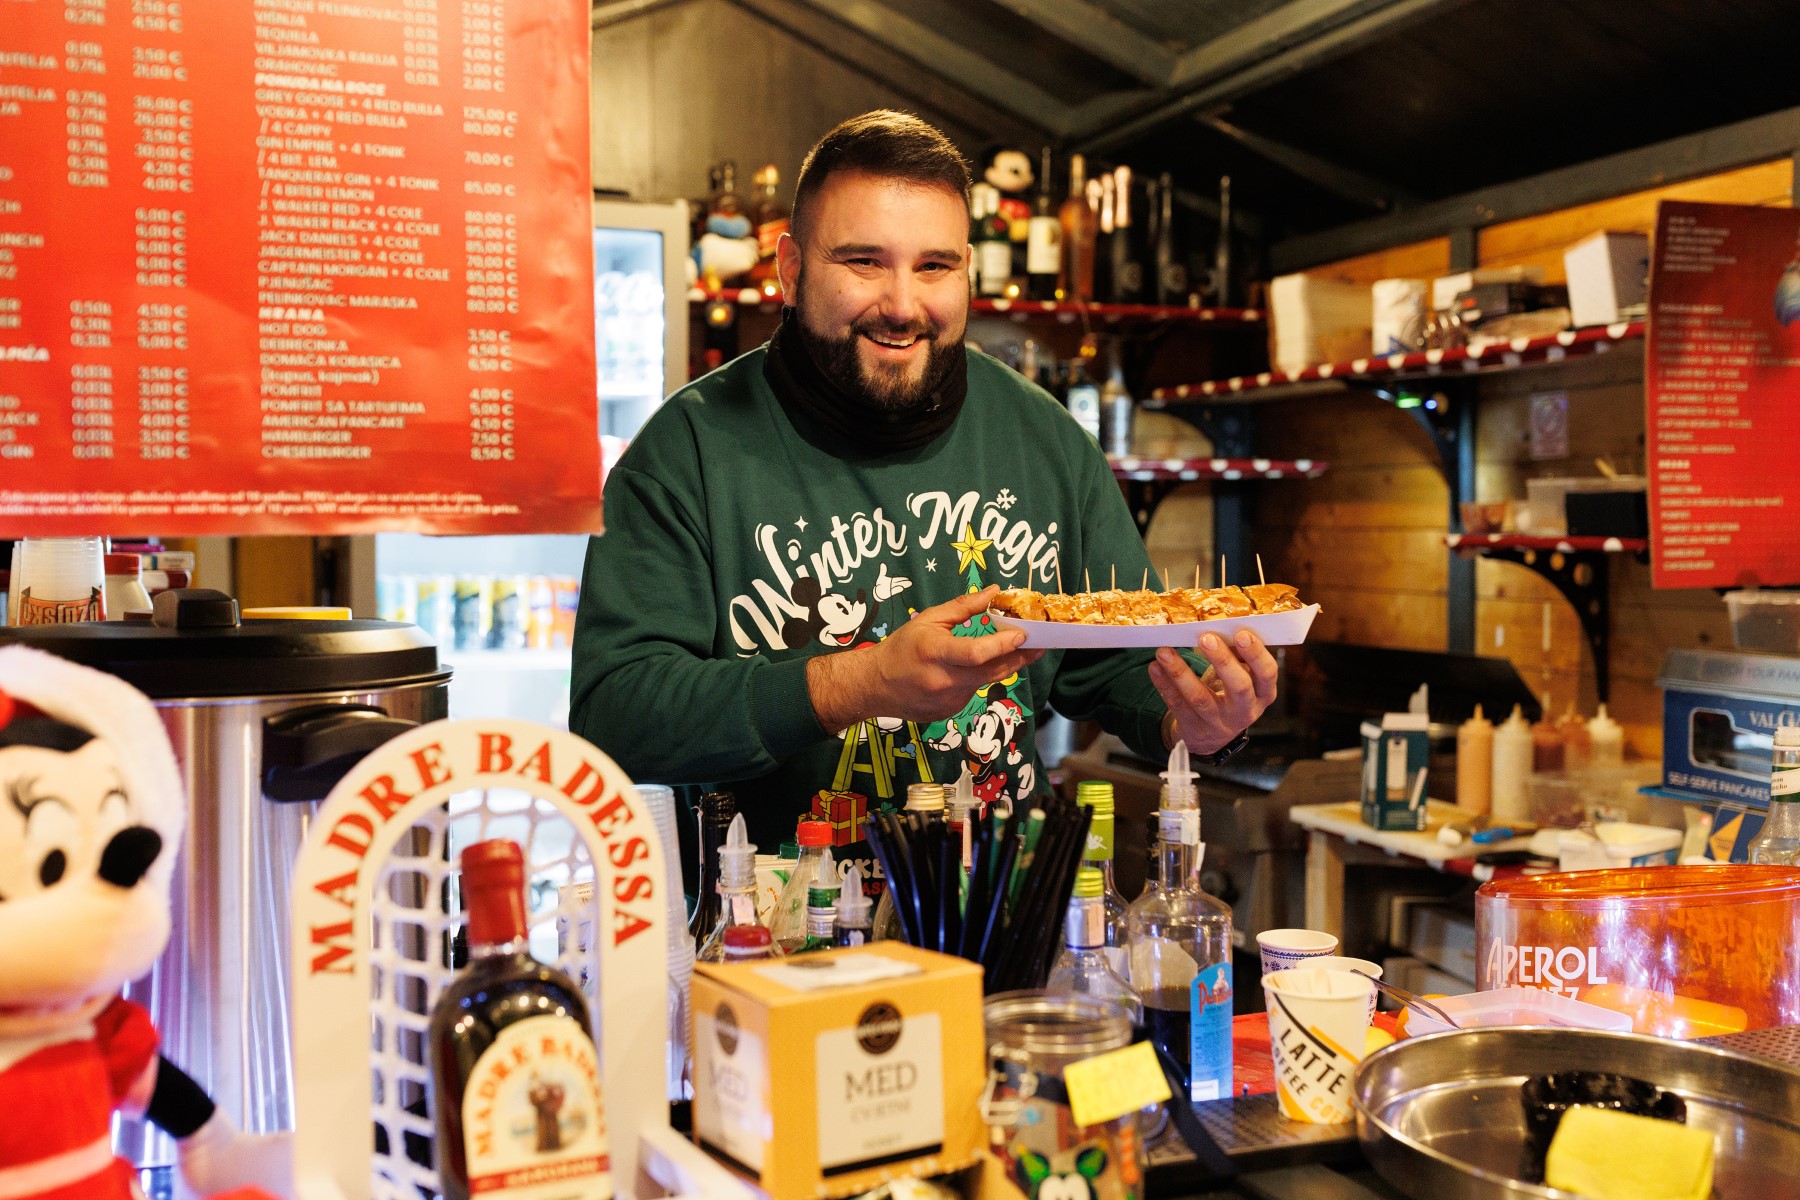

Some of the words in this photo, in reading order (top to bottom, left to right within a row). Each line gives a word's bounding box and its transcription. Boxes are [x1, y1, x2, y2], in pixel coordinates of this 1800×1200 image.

[730, 506, 907, 650] Winter
[910, 490, 1059, 584] Magic
[311, 743, 453, 976] MADRE
[476, 733, 655, 948] BADESSA
[1486, 936, 1607, 985] APEROL
[845, 1060, 918, 1102] MED
[1280, 1028, 1347, 1095] LATTE
